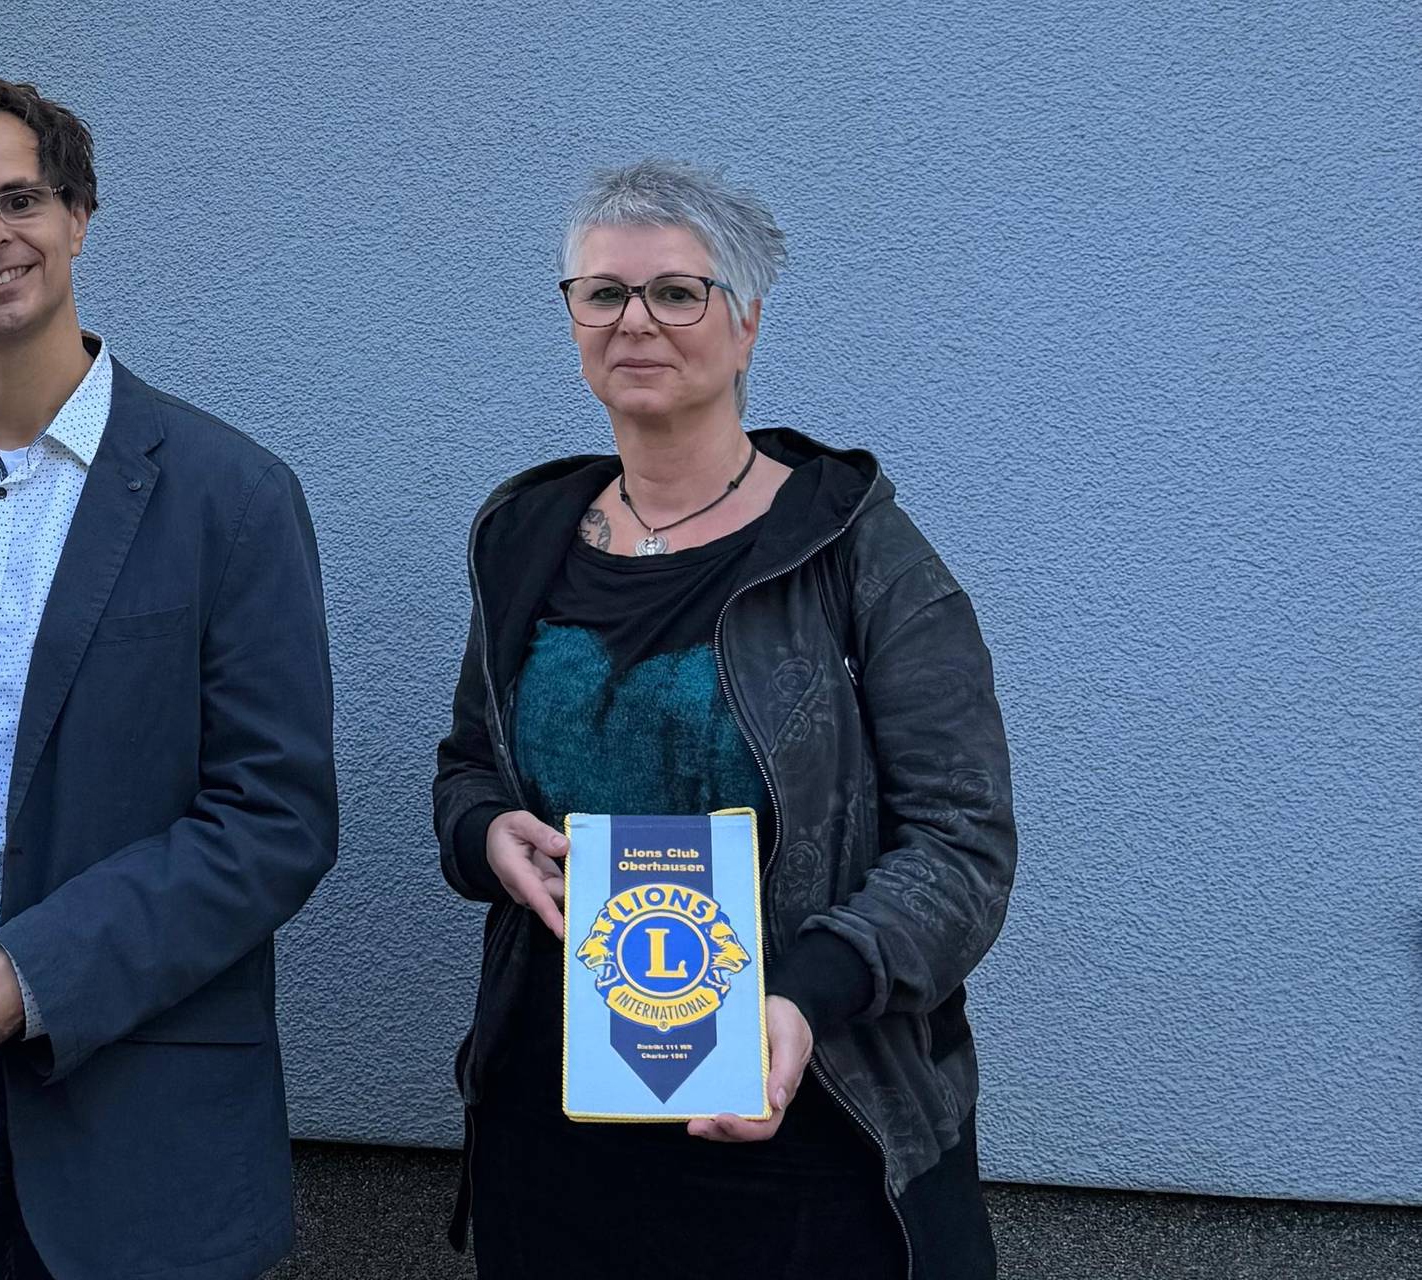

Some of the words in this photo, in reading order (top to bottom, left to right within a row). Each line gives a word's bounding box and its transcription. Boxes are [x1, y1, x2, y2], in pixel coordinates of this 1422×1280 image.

[618, 861, 705, 872] Oberhausen
[624, 848, 662, 858] Lions
[667, 848, 699, 858] Club
[614, 887, 711, 919] LIONS
[644, 928, 688, 978] L
[614, 991, 712, 1020] INTERNATIONAL
